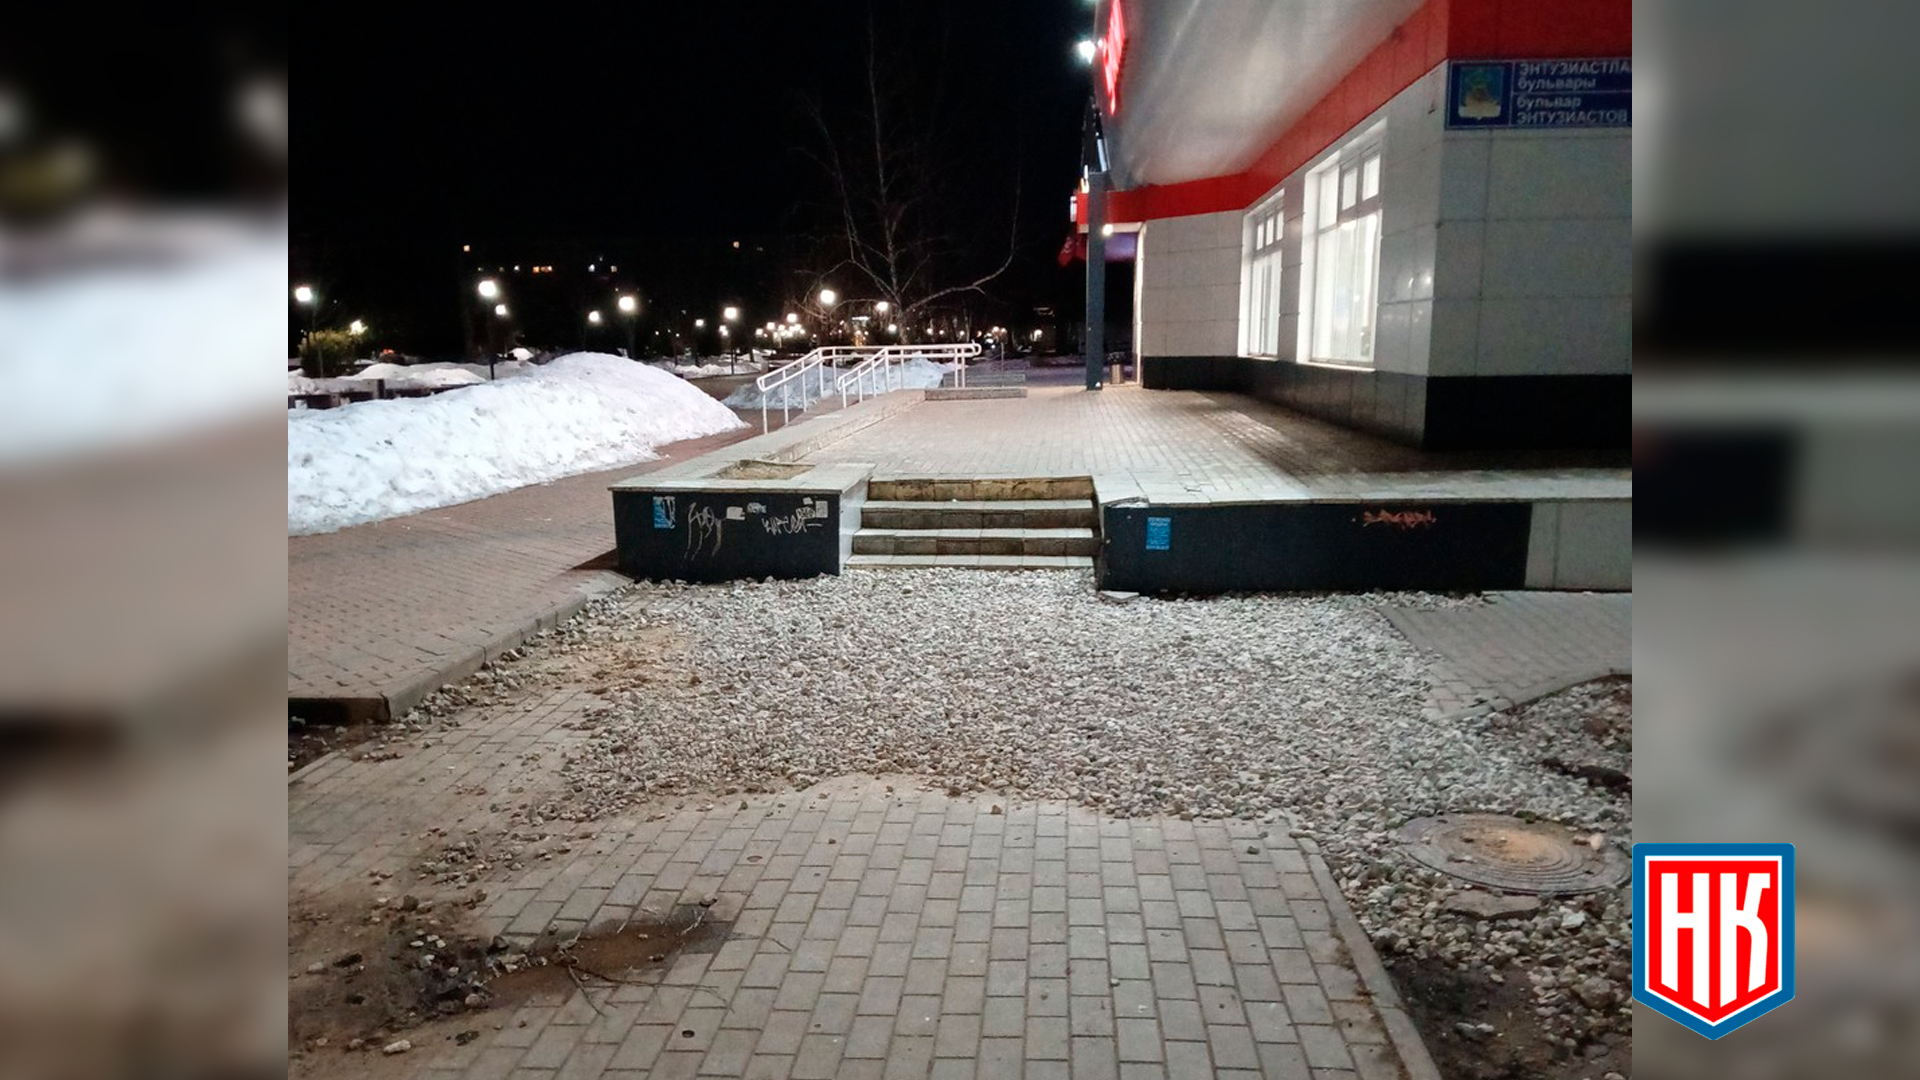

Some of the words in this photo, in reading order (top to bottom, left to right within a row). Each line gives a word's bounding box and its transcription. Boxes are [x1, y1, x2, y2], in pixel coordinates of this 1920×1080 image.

[1520, 62, 1632, 75] ЭНТУЗИАСТЛА
[1518, 77, 1596, 92] бульвары
[1517, 95, 1582, 111] бульвар
[1517, 110, 1627, 124] ЭНТУЗИАСТОВ
